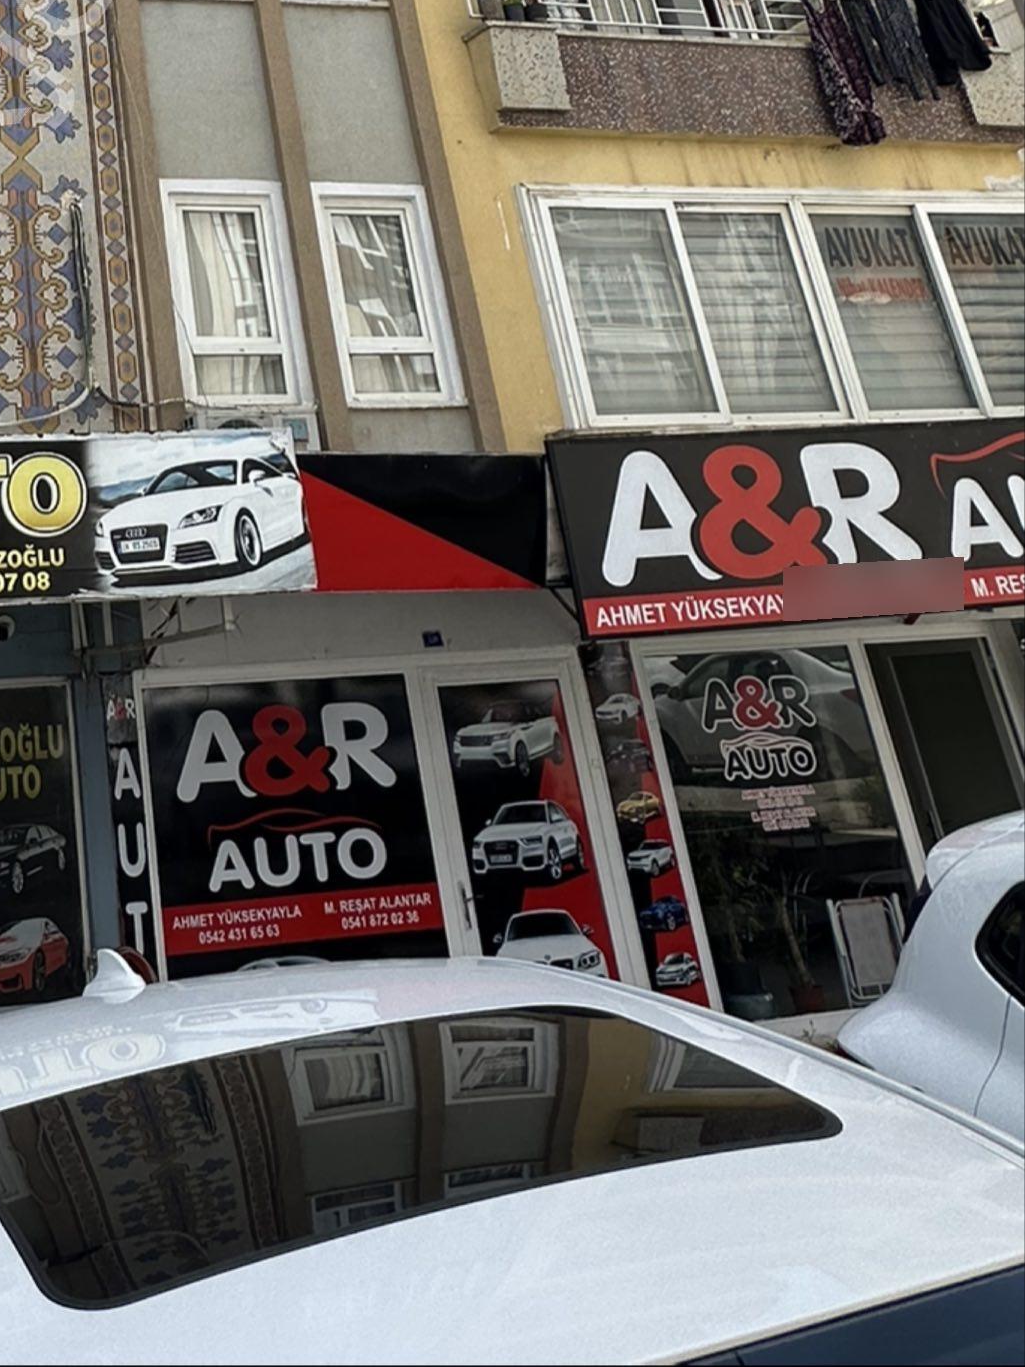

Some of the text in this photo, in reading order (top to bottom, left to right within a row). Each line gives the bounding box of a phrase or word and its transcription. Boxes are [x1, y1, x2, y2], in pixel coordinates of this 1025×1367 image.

[825, 226, 915, 267] AVUKAT
[602, 442, 923, 587] A&R
[22, 571, 51, 591] 08
[970, 577, 995, 598] M.
[596, 602, 666, 628] AHMET
[701, 675, 817, 733] A&R
[177, 702, 397, 803] A&R
[724, 744, 818, 781] AUTO
[114, 747, 148, 954] AUT
[209, 826, 388, 894] AUTO
[173, 904, 303, 930] AHMET YÜKSEKYAYLA
[324, 892, 432, 915] M. REŞAT ALANTAR
[199, 930, 226, 945] 0542
[228, 928, 247, 941] 431
[341, 916, 366, 930] 0541
